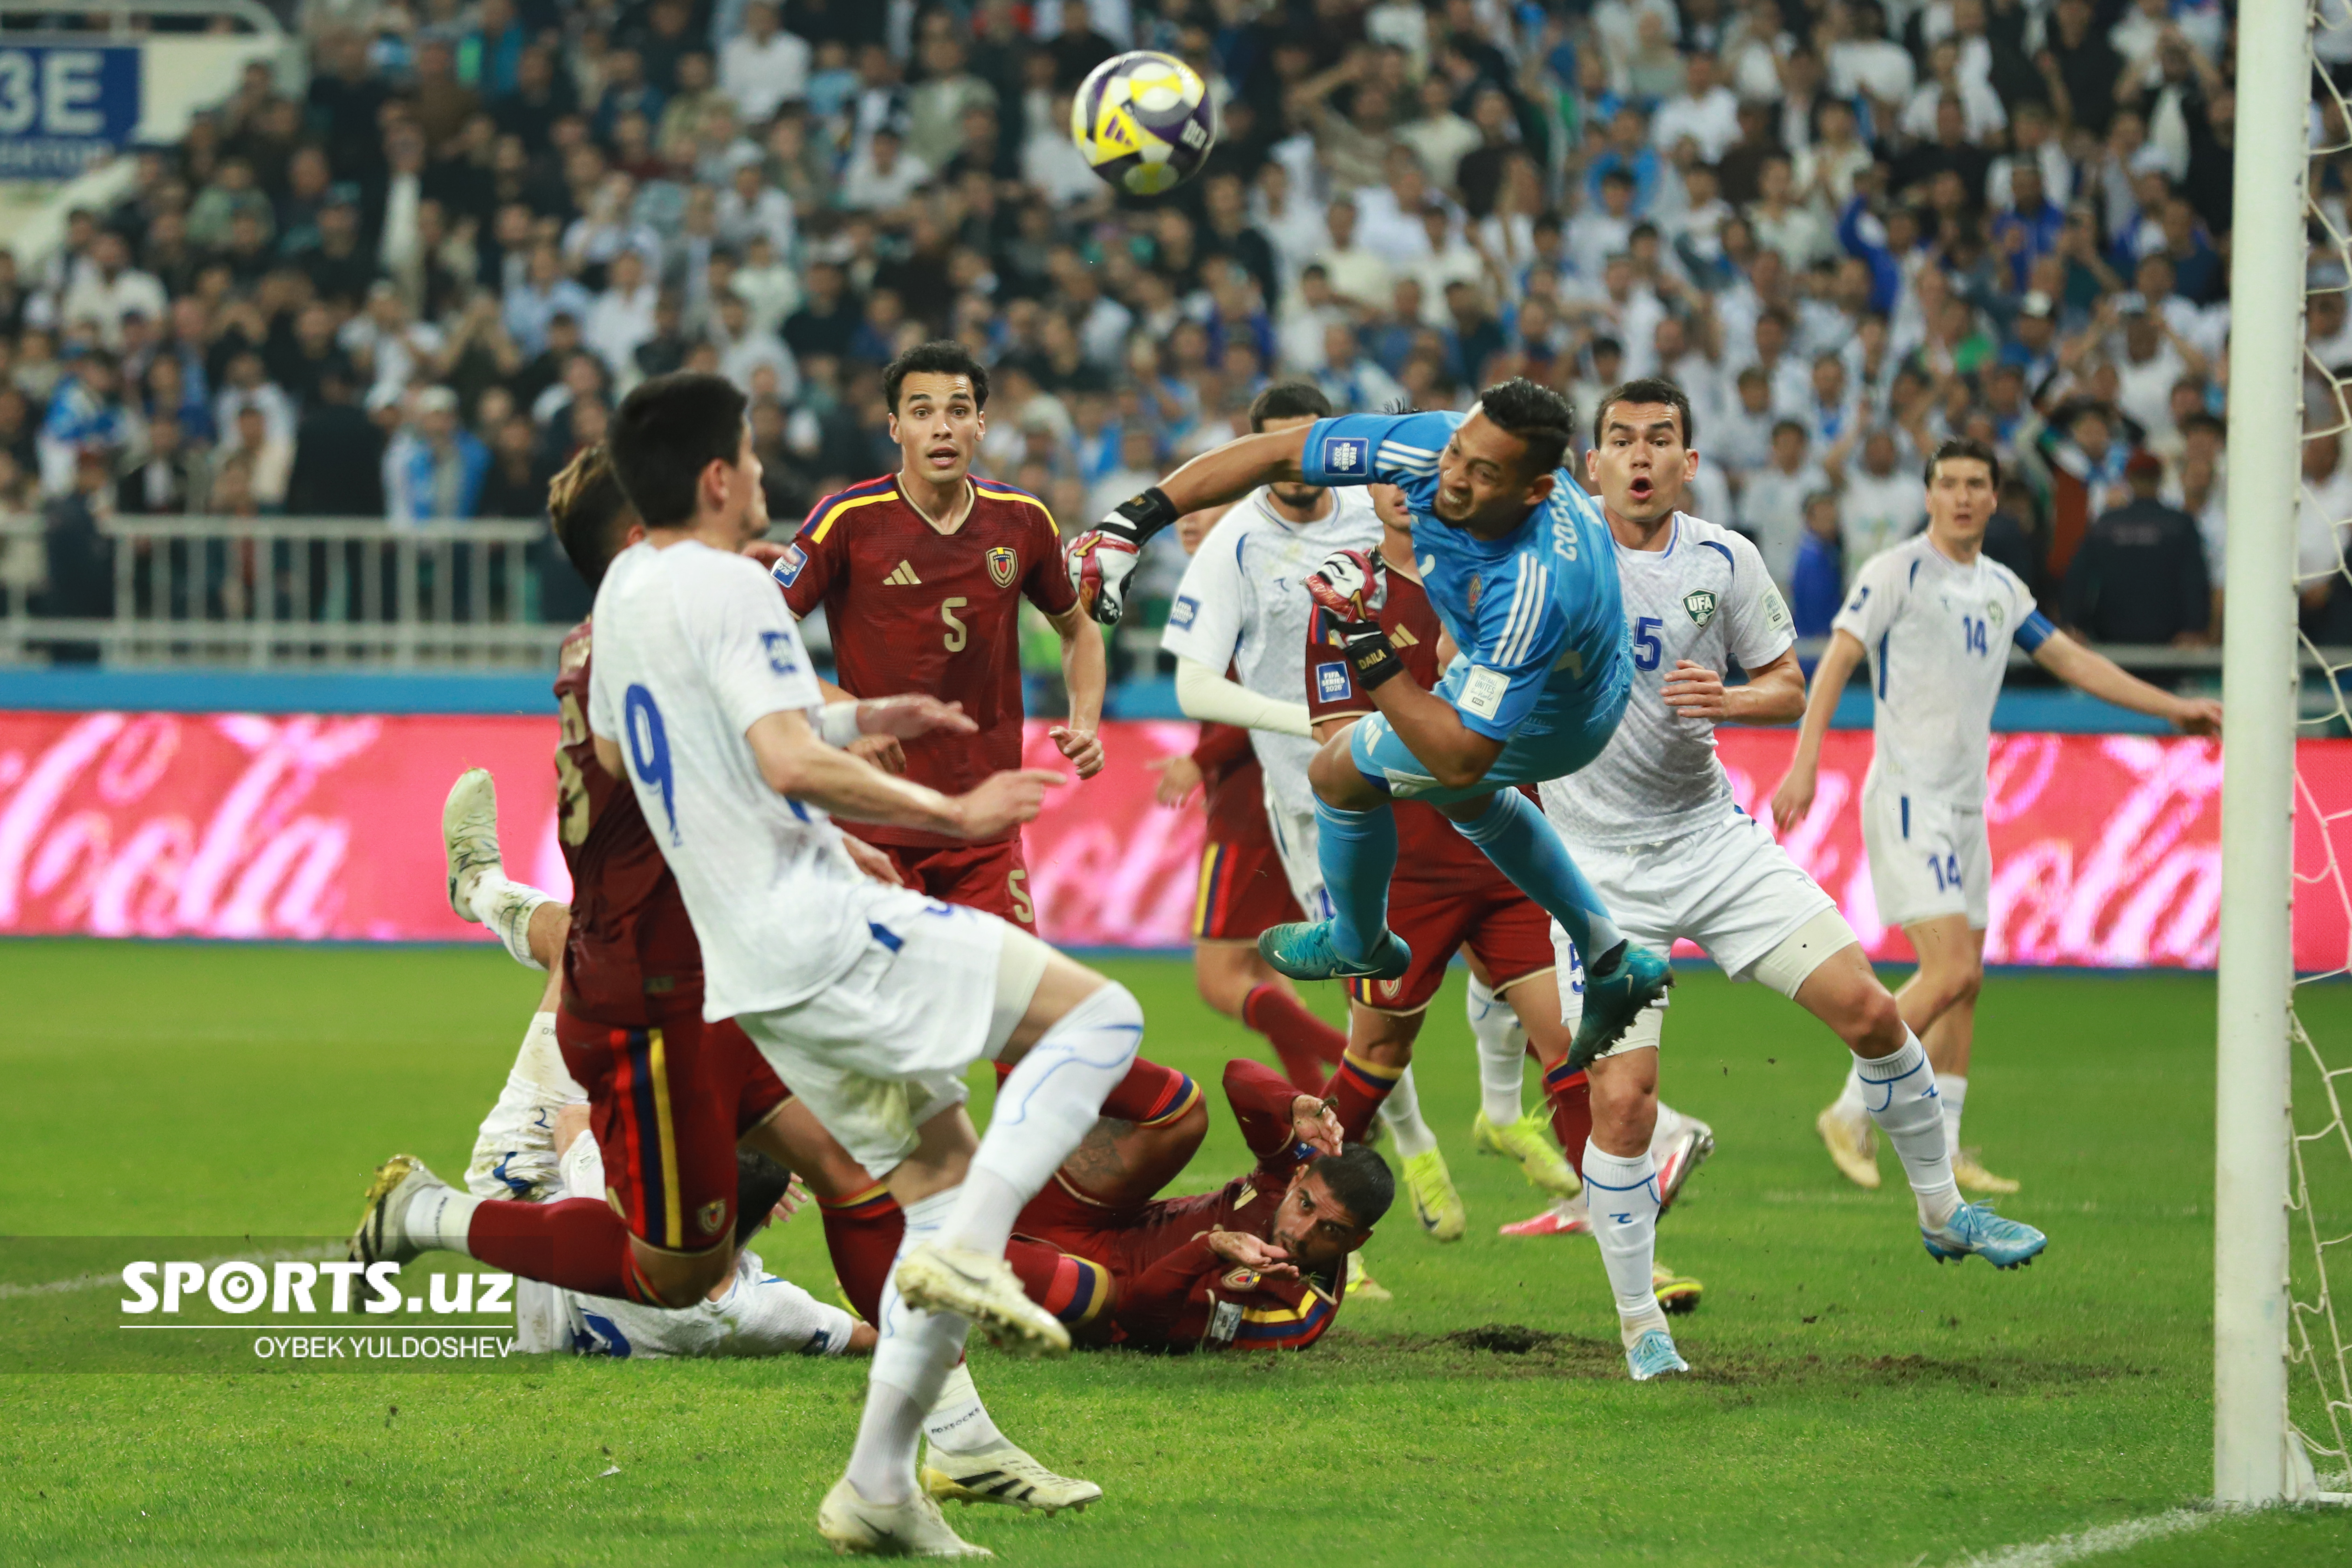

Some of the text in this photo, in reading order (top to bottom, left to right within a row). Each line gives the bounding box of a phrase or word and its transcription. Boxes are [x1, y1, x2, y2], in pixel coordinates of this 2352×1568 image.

[1333, 446, 1342, 467] 2026
[1342, 443, 1351, 471] SERIES
[1349, 446, 1358, 466] FIFA
[1687, 596, 1714, 612] UFA
[942, 596, 967, 652] 5
[1634, 616, 1663, 671] 5
[1963, 616, 1988, 657] 14
[1358, 649, 1387, 670] DAILA
[1322, 676, 1345, 687] SERIES
[1324, 671, 1341, 680] FIFA
[1479, 673, 1498, 686] FOOTBALL
[1475, 679, 1495, 694] UNITES
[623, 683, 675, 832] 9
[1927, 855, 1963, 892] 14
[1008, 869, 1034, 923] 5
